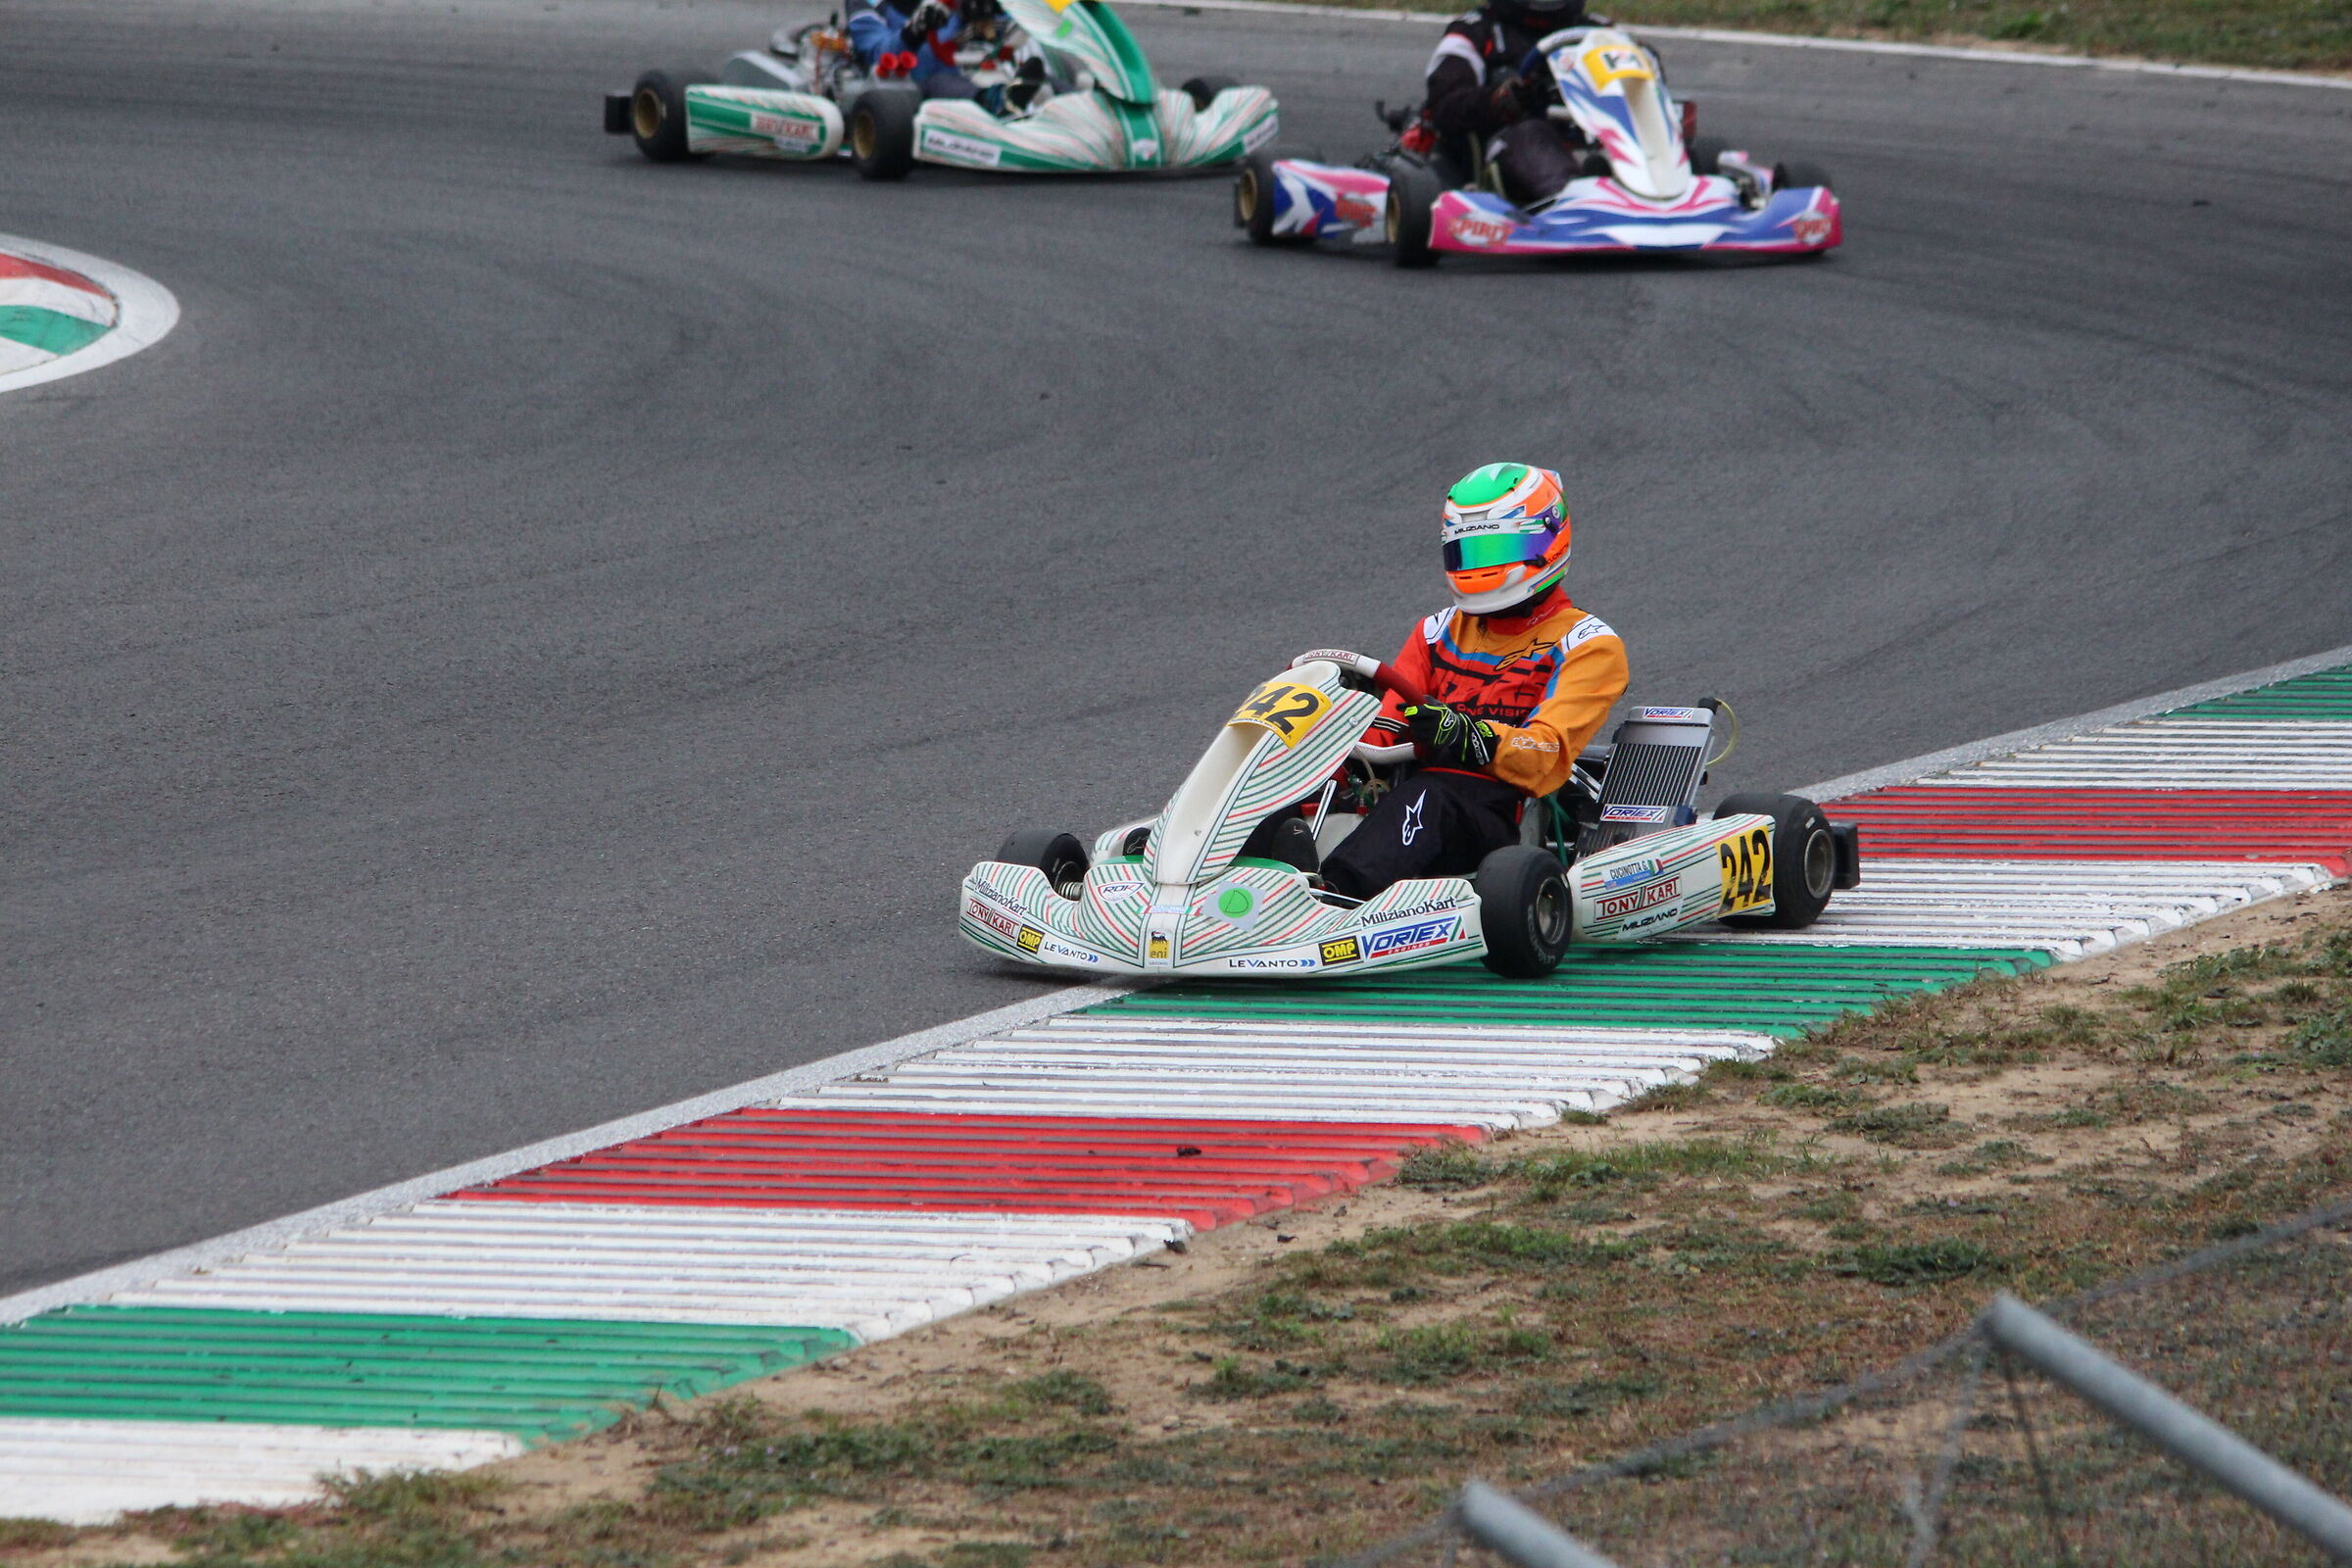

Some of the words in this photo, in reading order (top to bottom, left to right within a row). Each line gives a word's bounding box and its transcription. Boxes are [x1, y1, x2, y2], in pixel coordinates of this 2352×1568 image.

[1457, 704, 1485, 716] ONE
[1645, 708, 1687, 716] VORTEX
[1603, 806, 1663, 818] VORTEX
[1718, 829, 1772, 915] 242
[975, 878, 1028, 915] MilizianoKart
[1103, 885, 1137, 894] ROK
[1596, 891, 1640, 916] TONY
[1646, 876, 1681, 904] KART
[969, 900, 990, 919] TONY
[992, 911, 1018, 936] KART
[1360, 896, 1456, 927] MilizianoKart
[1019, 930, 1041, 949] OMP
[1361, 916, 1455, 958] VORTEX
[1044, 941, 1088, 960] LEVANTO
[1151, 947, 1167, 958] eni
[1323, 942, 1355, 958] OMP
[1388, 941, 1431, 956] ENGINES
[1229, 958, 1298, 968] LEVANTO
